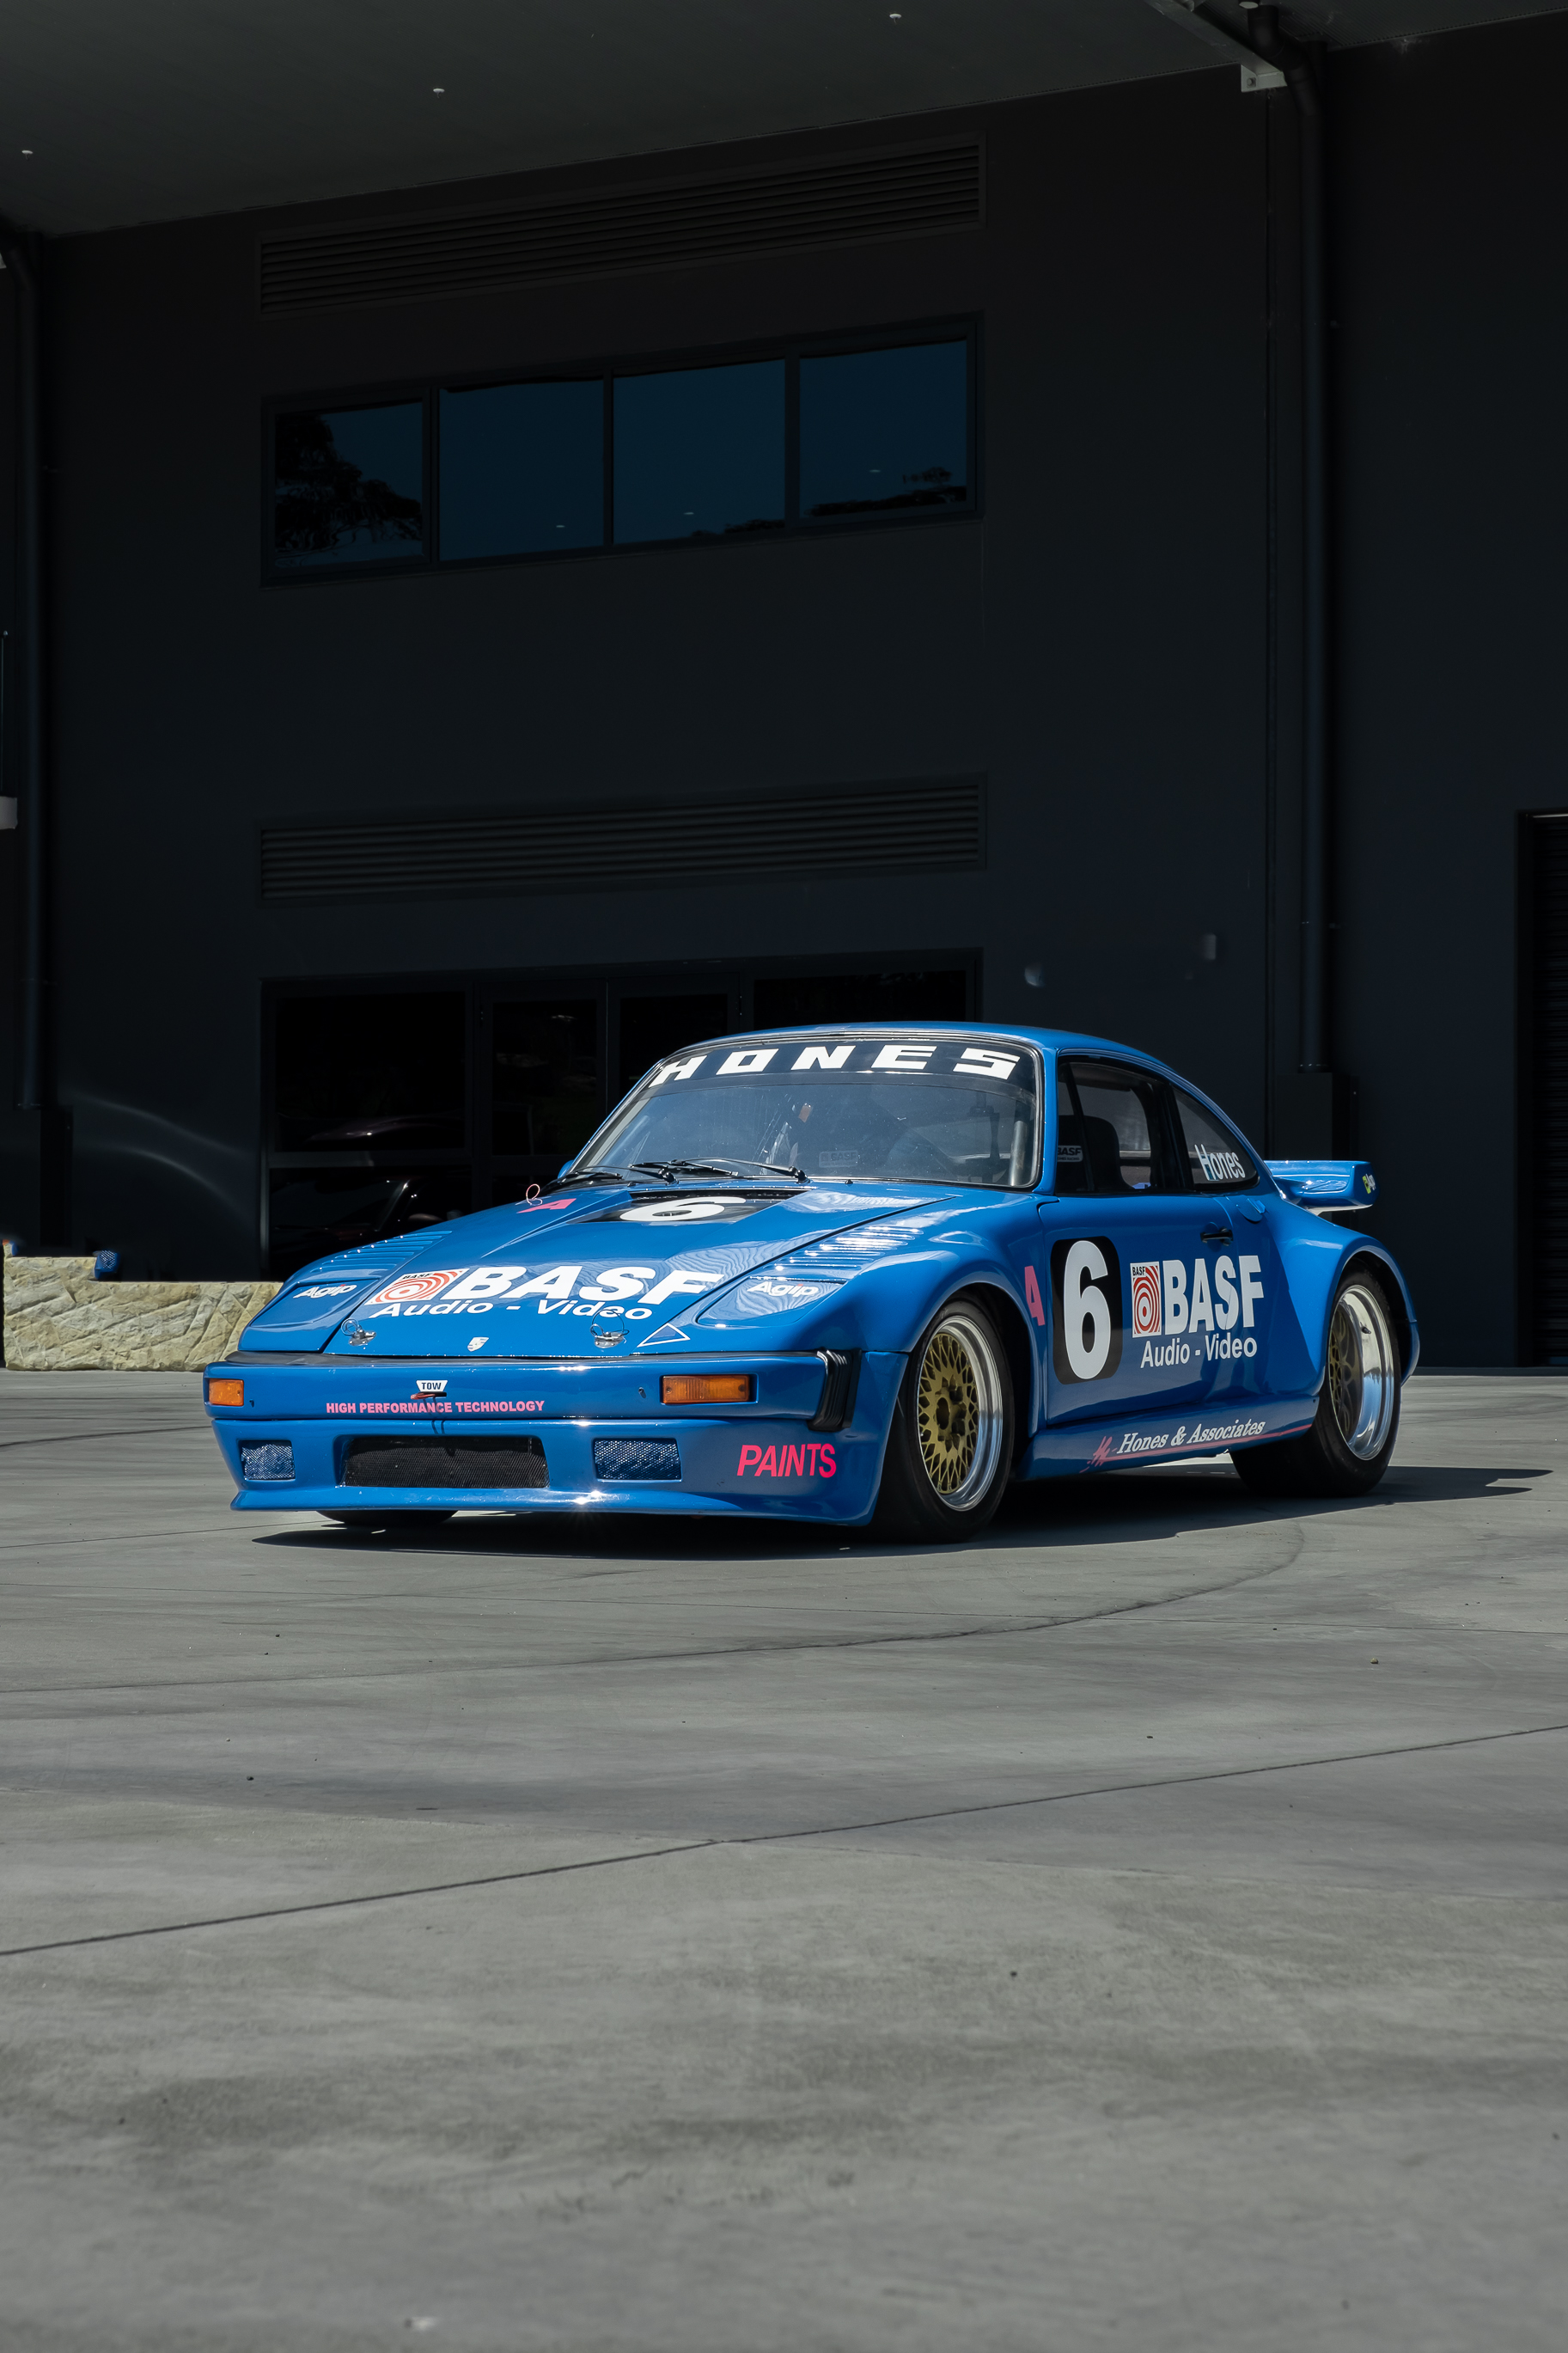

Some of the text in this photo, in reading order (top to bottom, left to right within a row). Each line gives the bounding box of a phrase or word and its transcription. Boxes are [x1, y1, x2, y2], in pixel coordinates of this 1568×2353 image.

[649, 1045, 1021, 1087] HONES
[1194, 1144, 1246, 1181] Hones
[619, 1196, 746, 1221] 6
[440, 1266, 724, 1305] BASF
[1132, 1266, 1145, 1276] BASF
[293, 1284, 357, 1299] Agip
[747, 1280, 819, 1298] Agip
[1024, 1265, 1046, 1326] A
[1162, 1255, 1265, 1335] BASF
[369, 1299, 493, 1318] Audio
[537, 1299, 653, 1320] Video
[1064, 1240, 1112, 1379] 6
[1140, 1337, 1190, 1369] Audio
[1205, 1332, 1257, 1361] Video
[421, 1382, 442, 1390] TOW
[326, 1400, 545, 1414] HIGH PERFORMANCE TECHNOLOGY
[1117, 1419, 1266, 1454] Hones & Associates
[737, 1443, 837, 1478] PAINTS
